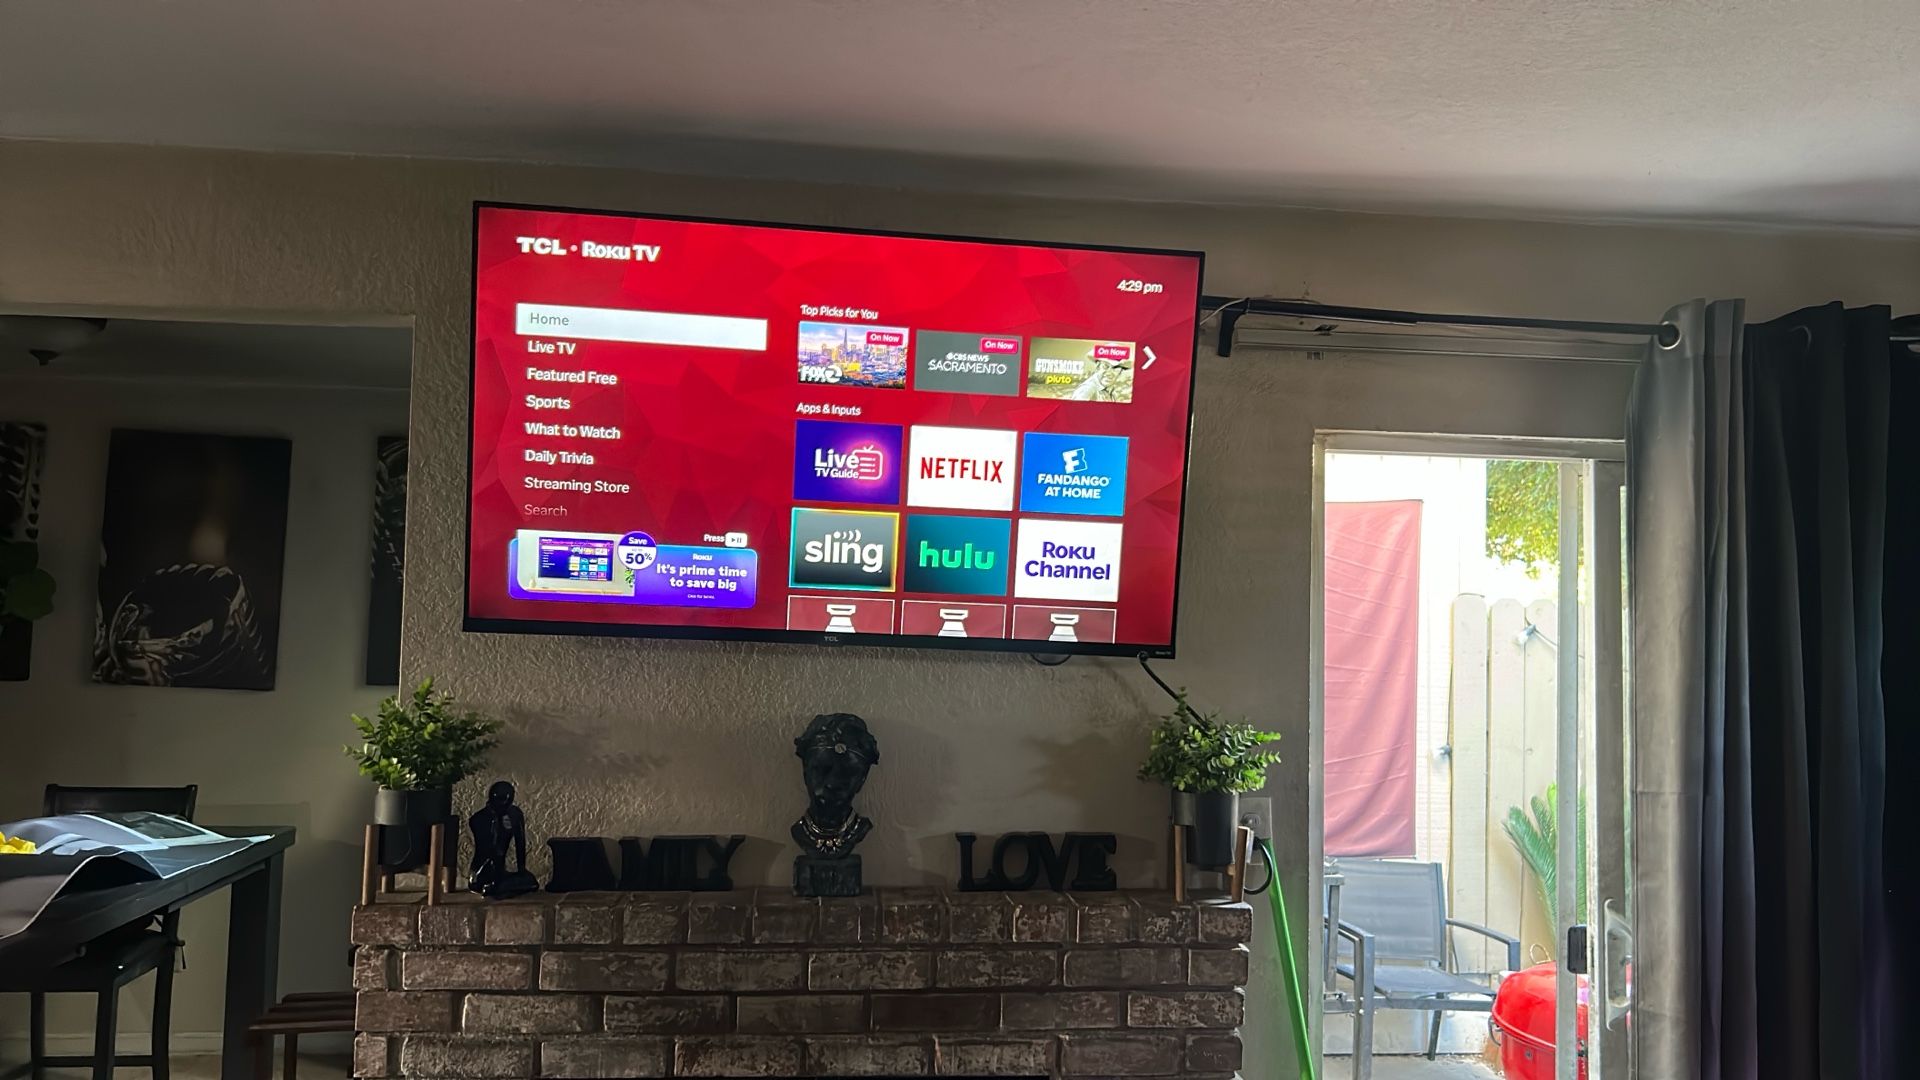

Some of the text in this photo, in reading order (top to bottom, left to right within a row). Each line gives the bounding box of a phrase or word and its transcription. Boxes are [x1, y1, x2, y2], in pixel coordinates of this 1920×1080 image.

[516, 236, 567, 256] TCL
[632, 244, 661, 263] TV
[1116, 278, 1163, 295] 4:29 pm
[529, 312, 570, 327] Home
[800, 304, 879, 321] Top Picks for You
[870, 333, 901, 343] On Now
[984, 340, 1014, 350] On Now
[527, 340, 576, 356] Live TV
[1097, 348, 1127, 357] On Now
[952, 353, 989, 363] CBS NEWS
[927, 359, 1008, 376] SACRAMENTO
[526, 367, 617, 386] Featured Free
[1045, 374, 1073, 385] pluto
[525, 394, 571, 410] Sports
[796, 403, 862, 418] Apps & Inputs
[524, 421, 622, 440] What to Watch
[524, 449, 594, 466] Daily Trivia
[814, 447, 860, 471] Live
[814, 466, 860, 480] TV Guide
[920, 456, 1004, 484] NETFLIX
[524, 476, 630, 495] Streaming Store
[1037, 473, 1110, 487] FANDANGO
[1044, 486, 1102, 499] AT HOME
[524, 503, 568, 518] Search
[628, 536, 648, 545] Save
[703, 533, 725, 544] Press
[625, 552, 653, 565] 50%
[804, 529, 884, 573] sling
[918, 540, 995, 570] hulu
[1041, 541, 1096, 561] Roku
[679, 564, 717, 578] prime
[718, 565, 748, 578] time
[1024, 560, 1111, 581] Channel
[669, 577, 737, 592] to save big
[955, 831, 1118, 891] LOVE
